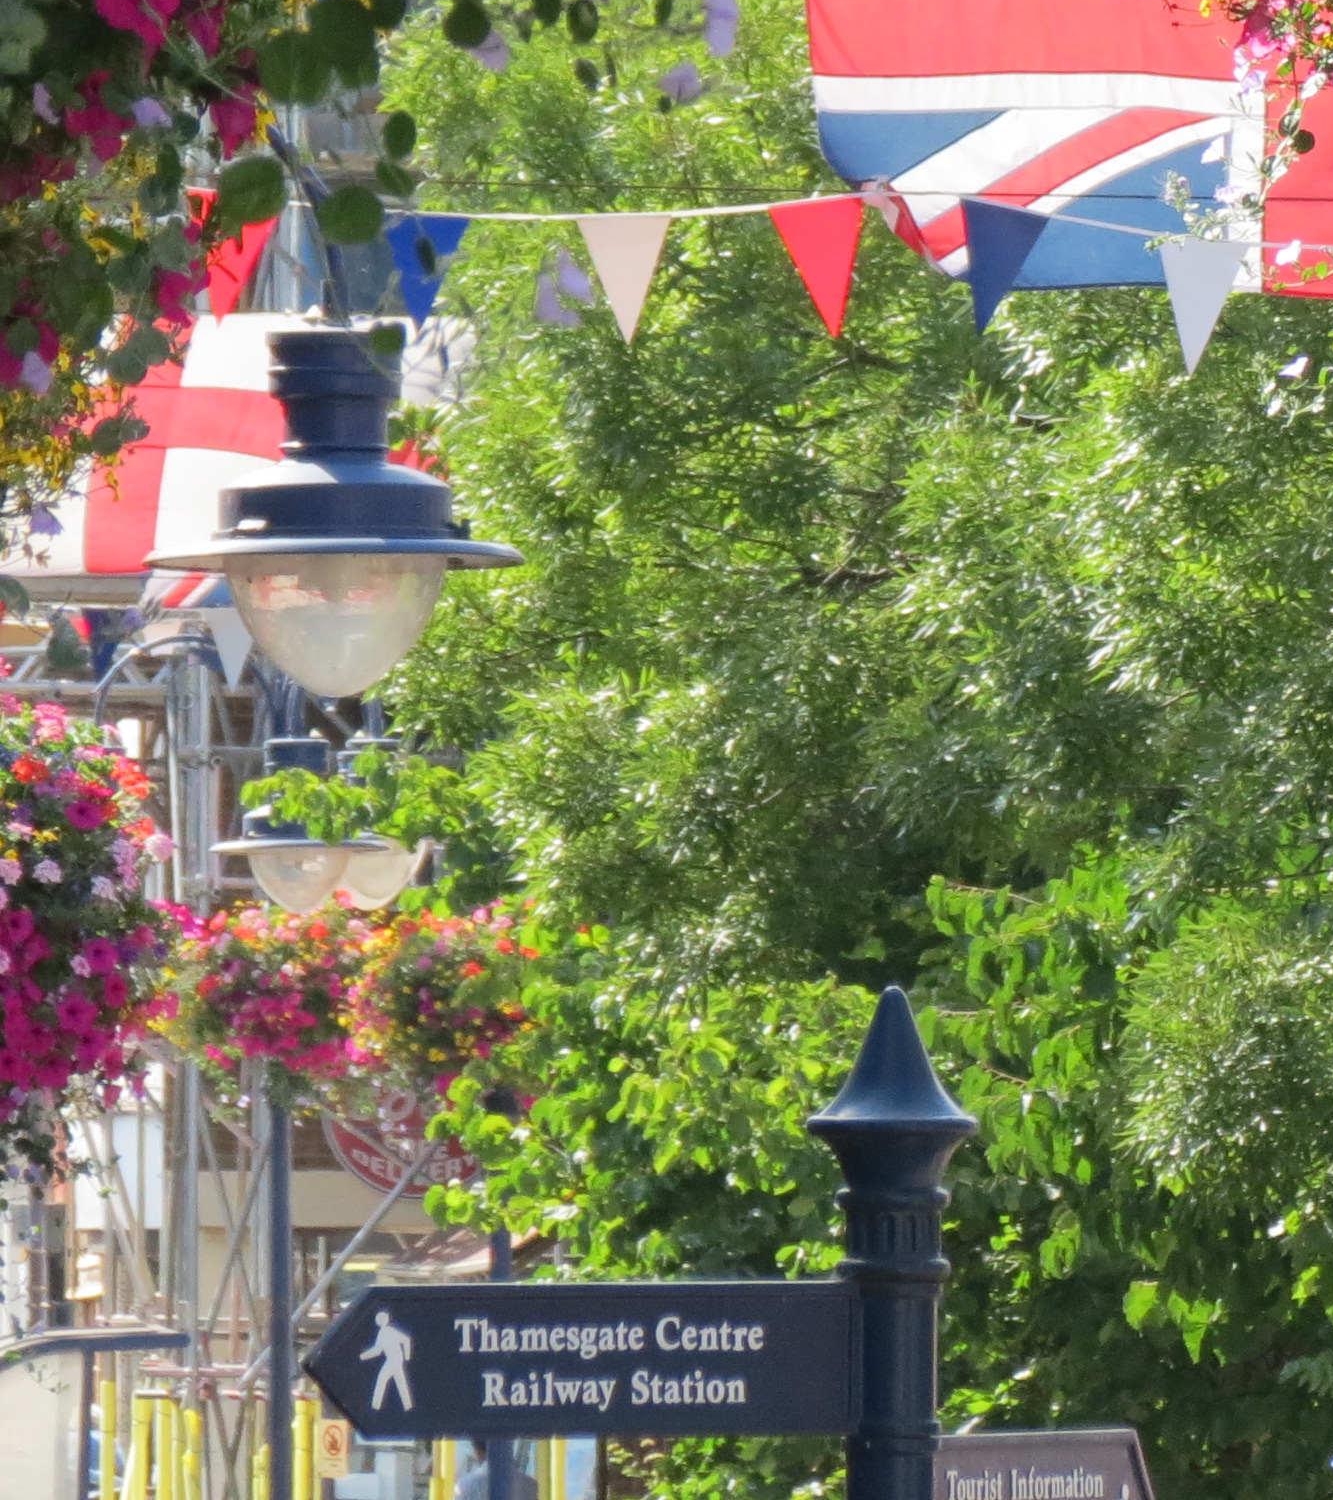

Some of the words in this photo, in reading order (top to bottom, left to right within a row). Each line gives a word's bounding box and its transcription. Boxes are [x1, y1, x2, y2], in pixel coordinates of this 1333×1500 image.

[453, 1317, 645, 1360] Thamesgate
[655, 1315, 765, 1351] Centre
[482, 1371, 617, 1412] Railway
[631, 1368, 746, 1404] Station
[946, 1468, 1003, 1500] Tourist
[1011, 1465, 1104, 1500] Information
